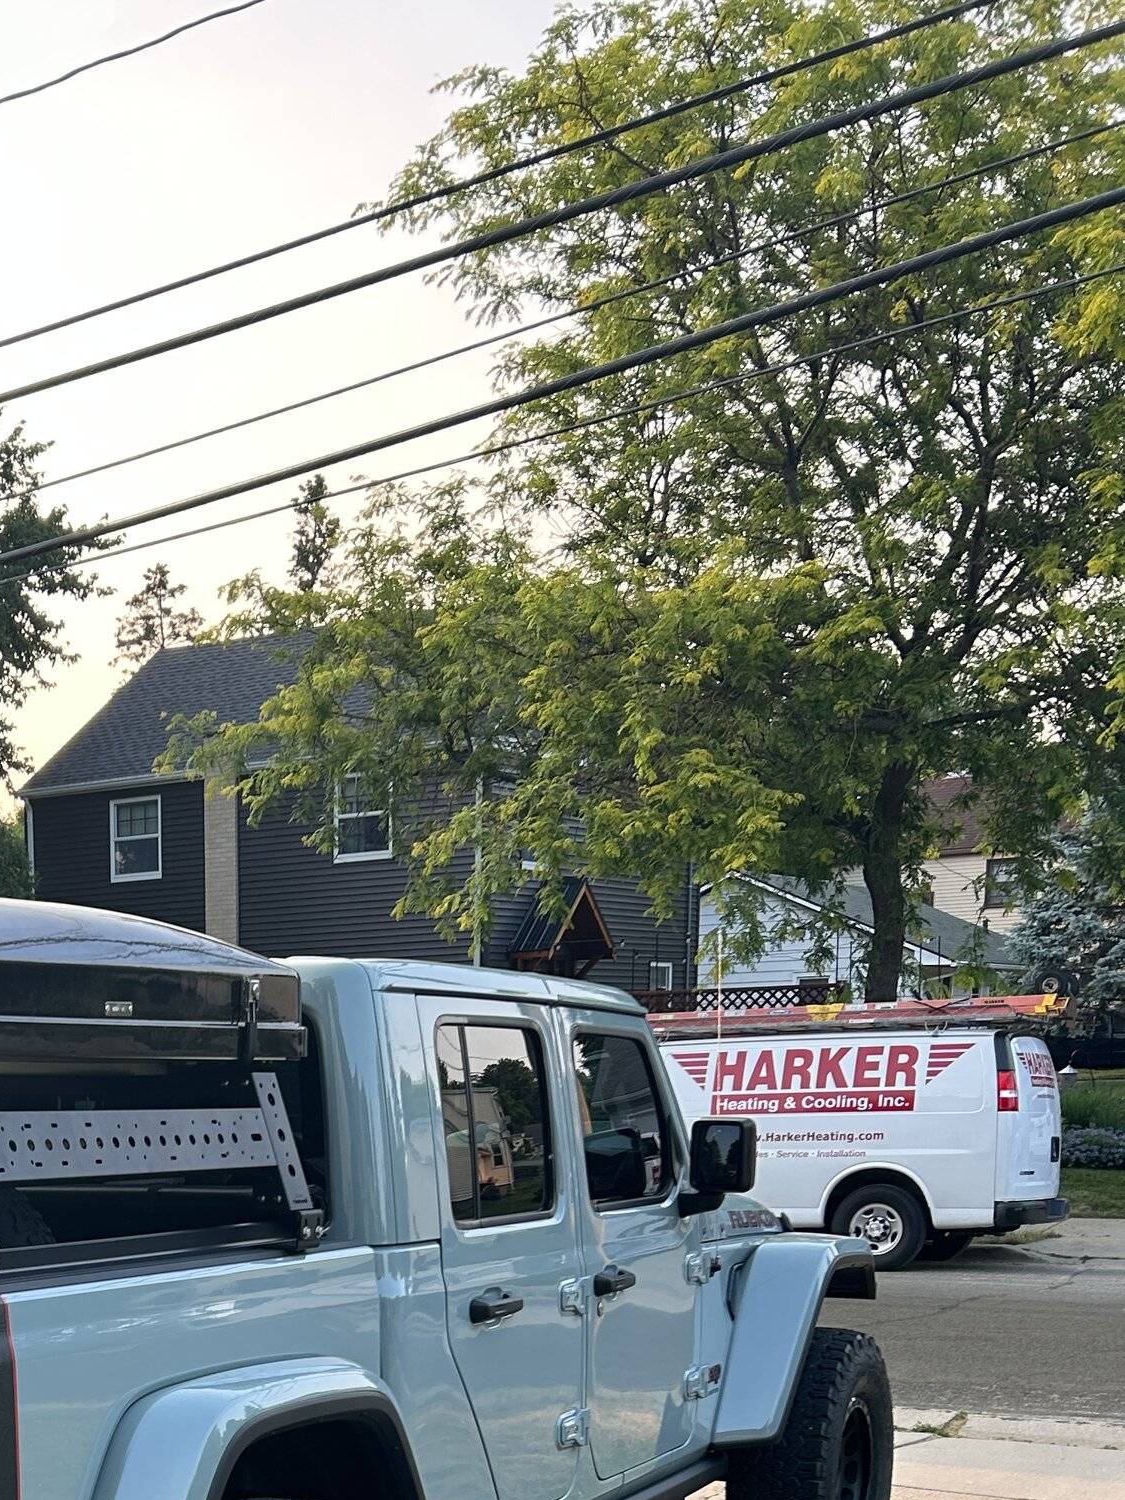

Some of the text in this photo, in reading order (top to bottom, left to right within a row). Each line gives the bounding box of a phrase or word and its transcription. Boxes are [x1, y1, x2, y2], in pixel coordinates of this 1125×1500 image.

[712, 1044, 919, 1092] HARKER
[716, 1094, 910, 1112] Heating & Cooling, Inc.
[776, 1150, 809, 1159] Service
[816, 1149, 866, 1158] Installation
